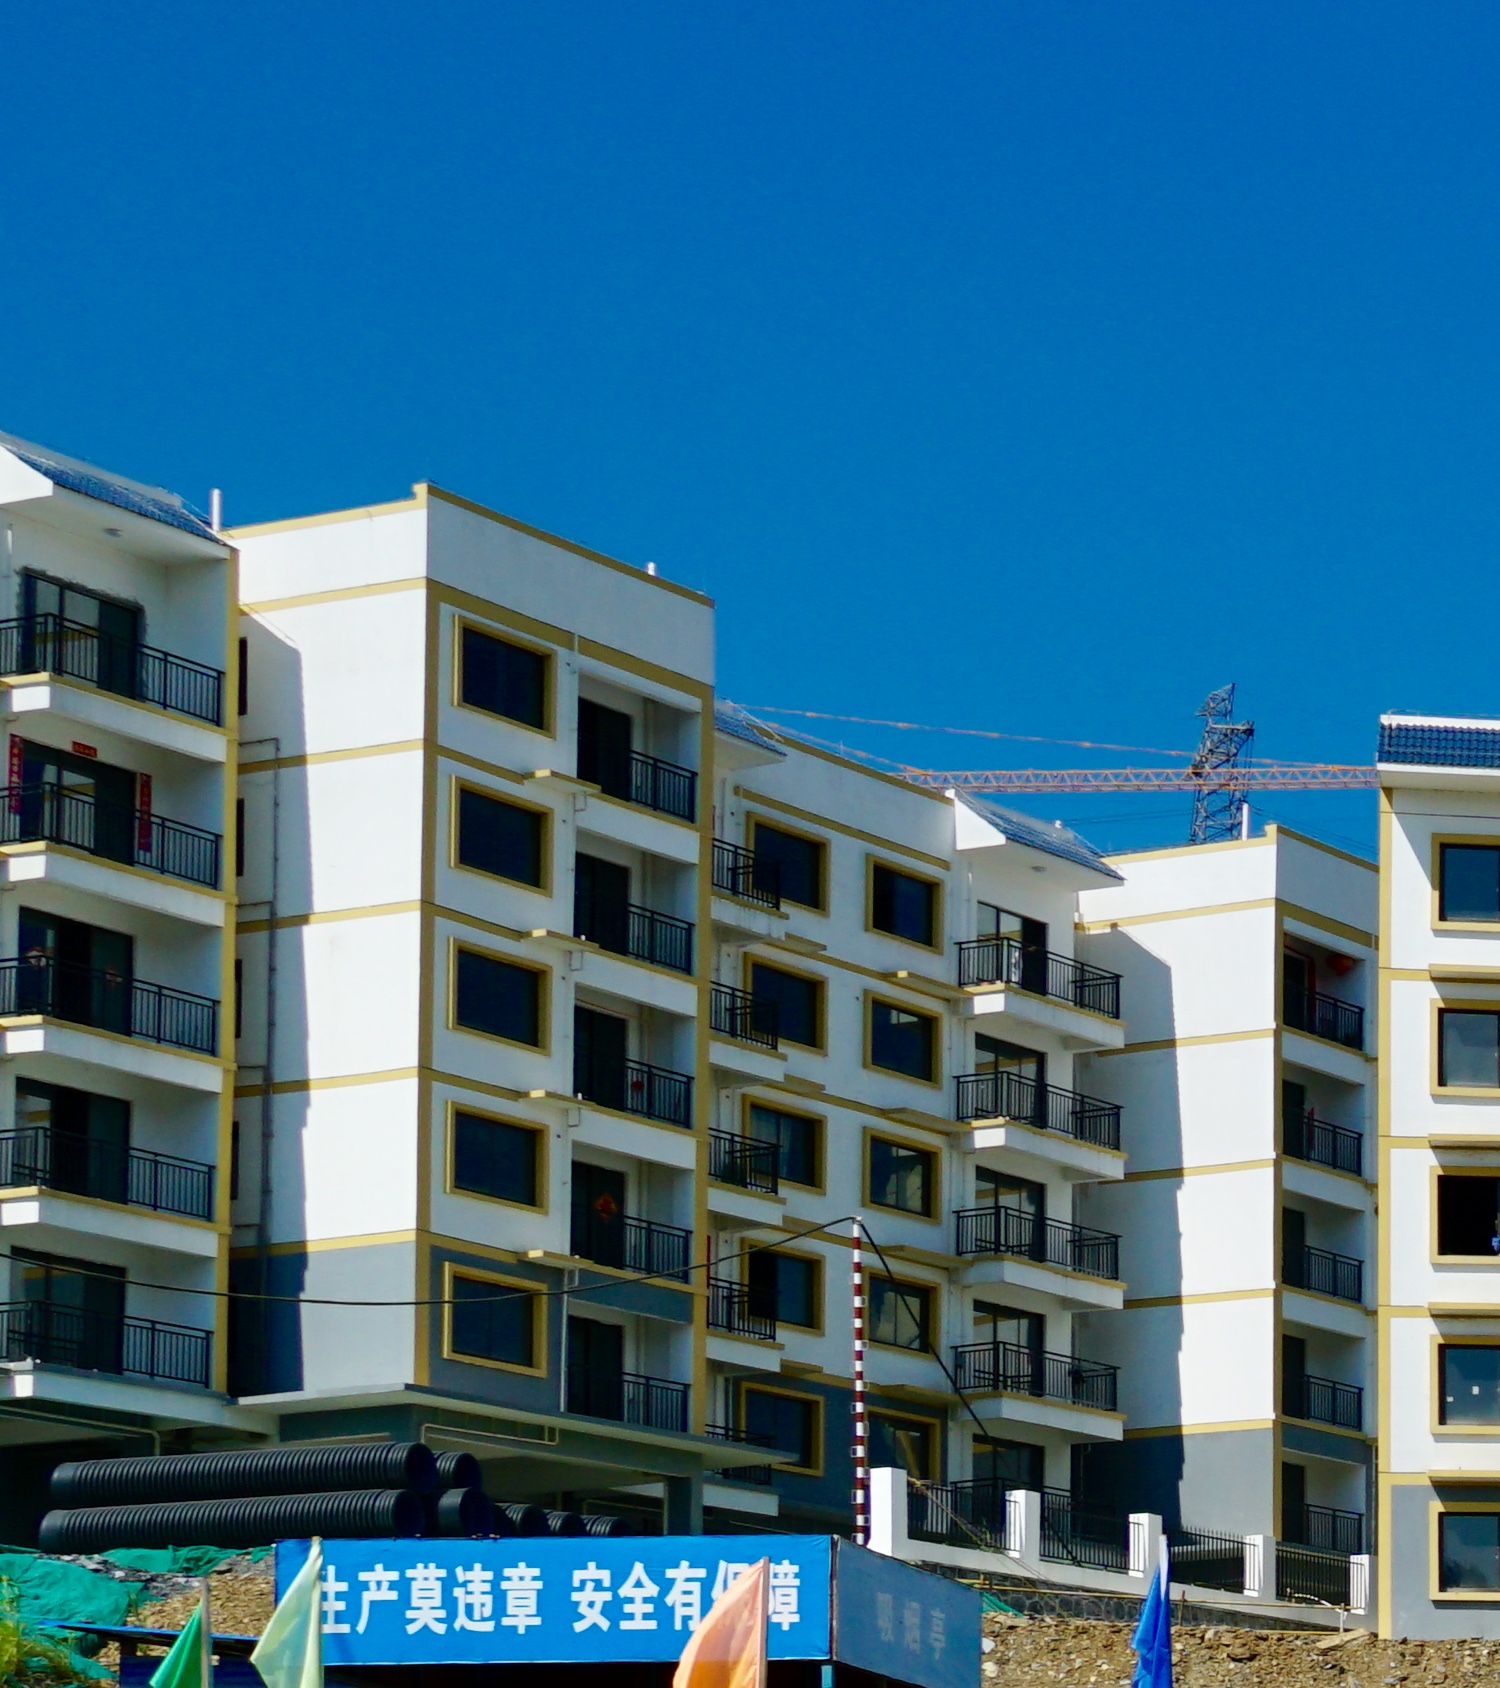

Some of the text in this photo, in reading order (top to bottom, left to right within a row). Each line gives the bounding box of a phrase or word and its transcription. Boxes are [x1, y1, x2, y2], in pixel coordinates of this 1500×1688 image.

[317, 1561, 543, 1635] 生产莫违章
